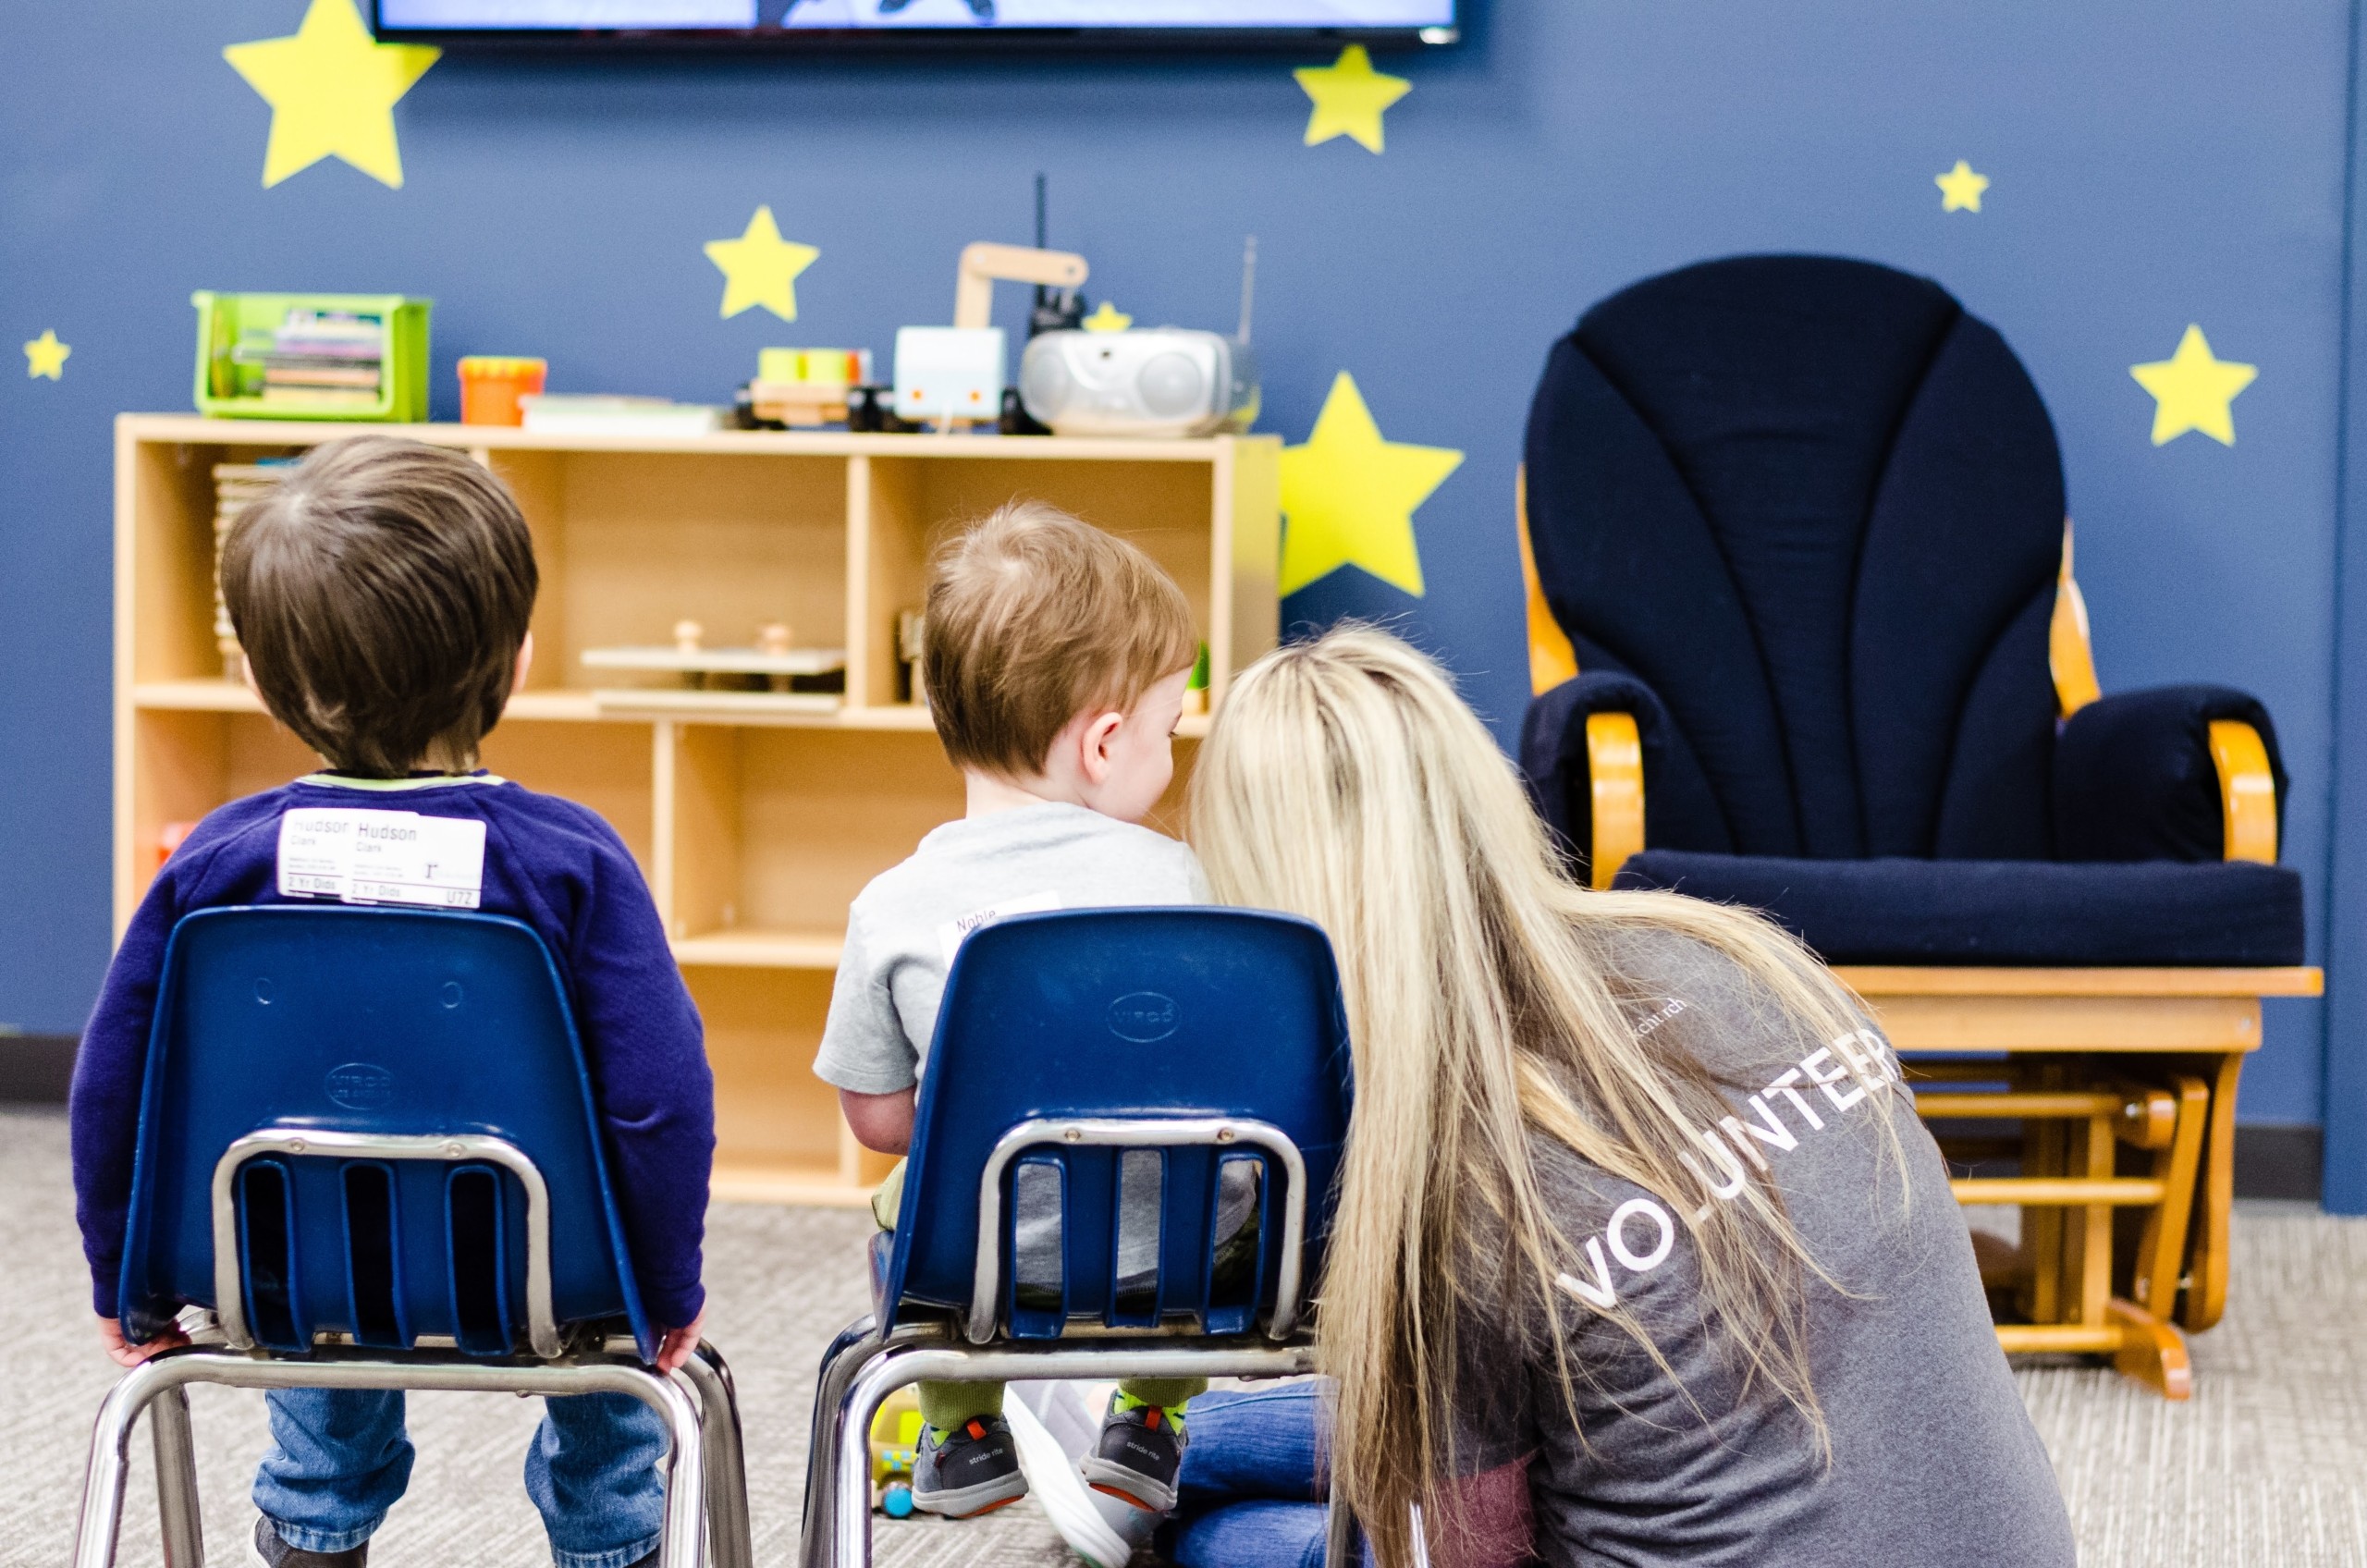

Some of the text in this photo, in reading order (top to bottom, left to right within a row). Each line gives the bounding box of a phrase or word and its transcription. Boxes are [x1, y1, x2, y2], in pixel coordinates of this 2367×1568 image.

[359, 822, 417, 841] Hudson
[956, 910, 996, 932] Noble
[1554, 1027, 1901, 1310] VOUNTEER
[969, 1448, 1003, 1465] stride rite
[1126, 1441, 1160, 1461] stride rite
